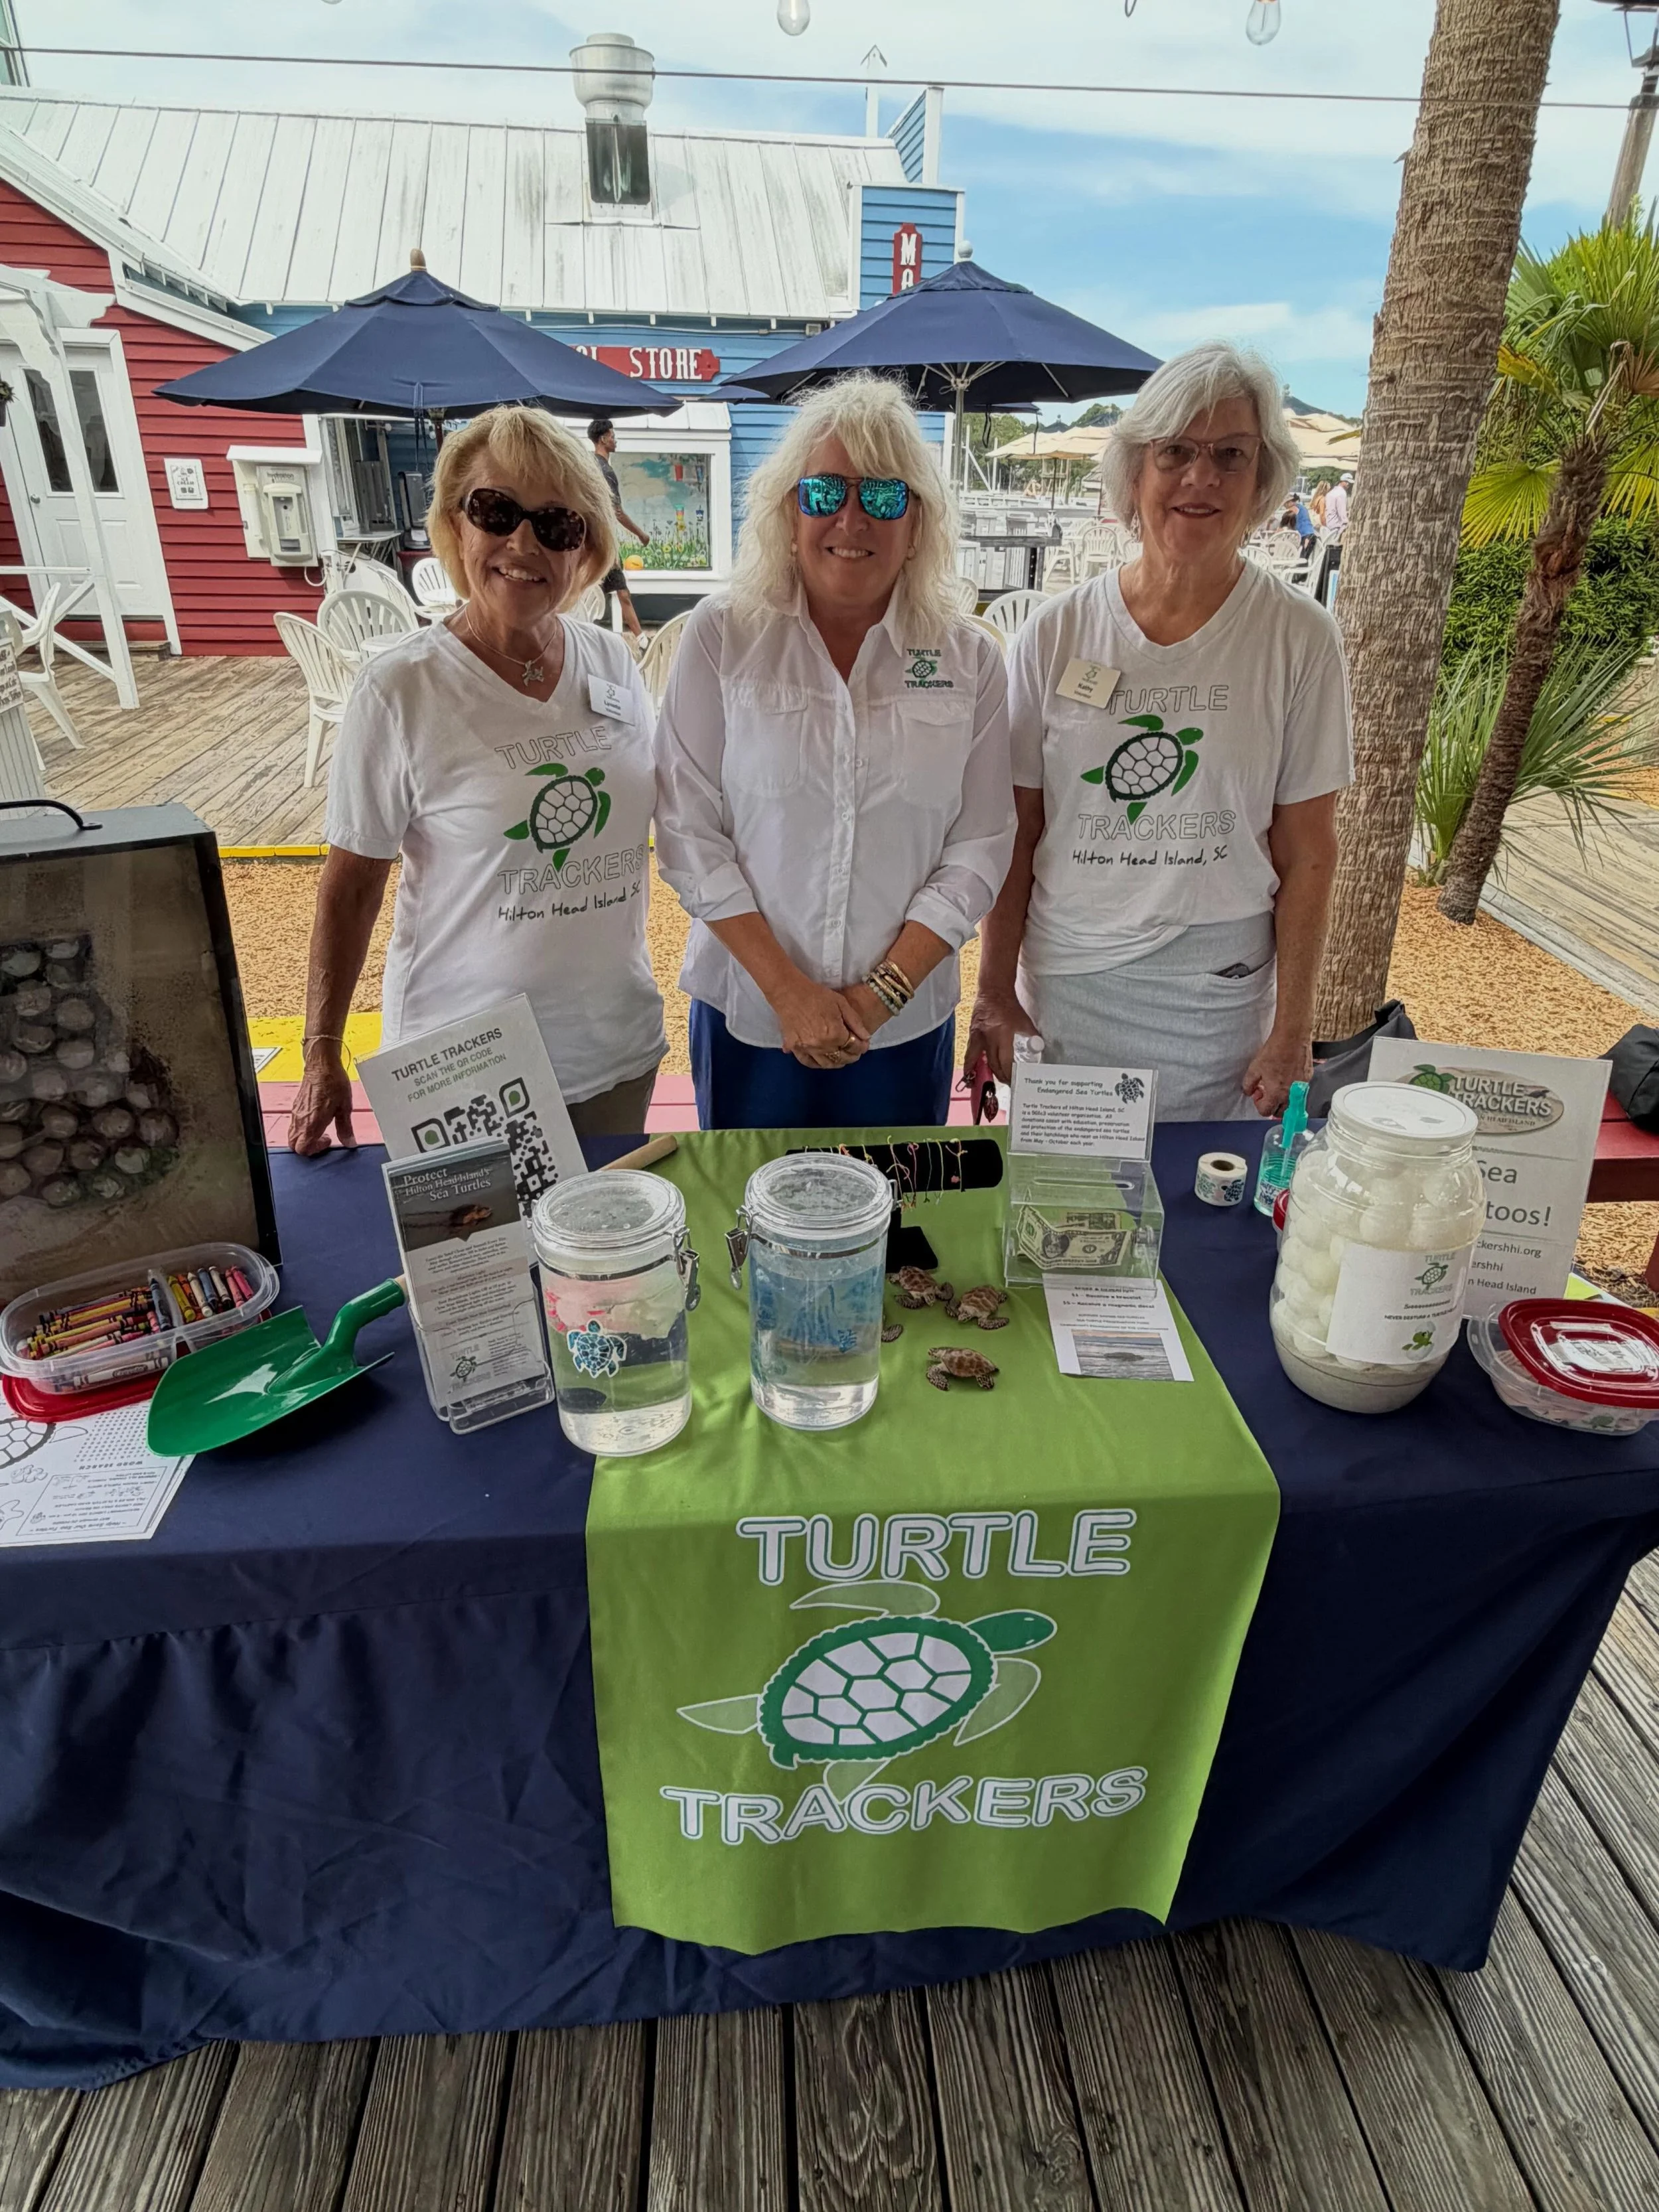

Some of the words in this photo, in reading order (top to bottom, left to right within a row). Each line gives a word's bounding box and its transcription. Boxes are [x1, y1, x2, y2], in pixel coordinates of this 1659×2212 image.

[629, 347, 702, 379] STORE
[1109, 685, 1229, 715] TURTLE
[494, 725, 611, 770] TURTLE
[1078, 810, 1236, 841] TRACKERS
[498, 844, 645, 895] TRACKERS
[1072, 849, 1114, 865] Hilton
[1120, 850, 1157, 866] Head
[1164, 848, 1206, 866] Island,
[1214, 844, 1228, 861] SC
[498, 905, 544, 922] Hilton
[551, 897, 587, 917] Head
[594, 887, 626, 910] Island
[392, 1053, 441, 1082] TURTLE
[441, 1027, 503, 1061] TRACKERS
[413, 1070, 438, 1086] SCAN
[439, 1063, 456, 1078] THE
[457, 1057, 469, 1069] QR
[470, 1047, 493, 1063] CODE
[407, 1090, 426, 1103] FOR
[427, 1078, 453, 1094] MORE
[453, 1053, 507, 1084] INFORMATION
[1037, 1086, 1073, 1095] Endangered
[1453, 1075, 1525, 1096] TURTLE
[1508, 1118, 1536, 1126] ISLAND
[402, 1167, 449, 1187] Protect
[405, 1183, 433, 1197] Hilton
[435, 1177, 457, 1189] Head
[457, 1168, 491, 1184] Island's
[1477, 1160, 1517, 1184] Sea
[429, 1189, 449, 1201] Sea
[451, 1178, 492, 1195] Turtles
[1424, 1252, 1455, 1262] TURTLE
[1410, 1284, 1453, 1296] TRACKERS
[1477, 1278, 1504, 1290] Head
[1506, 1282, 1537, 1295] Island
[78, 1462, 113, 1471] SEARCH
[736, 1509, 1137, 1586] TURTLE
[660, 1766, 1148, 1844] TRACKERS
